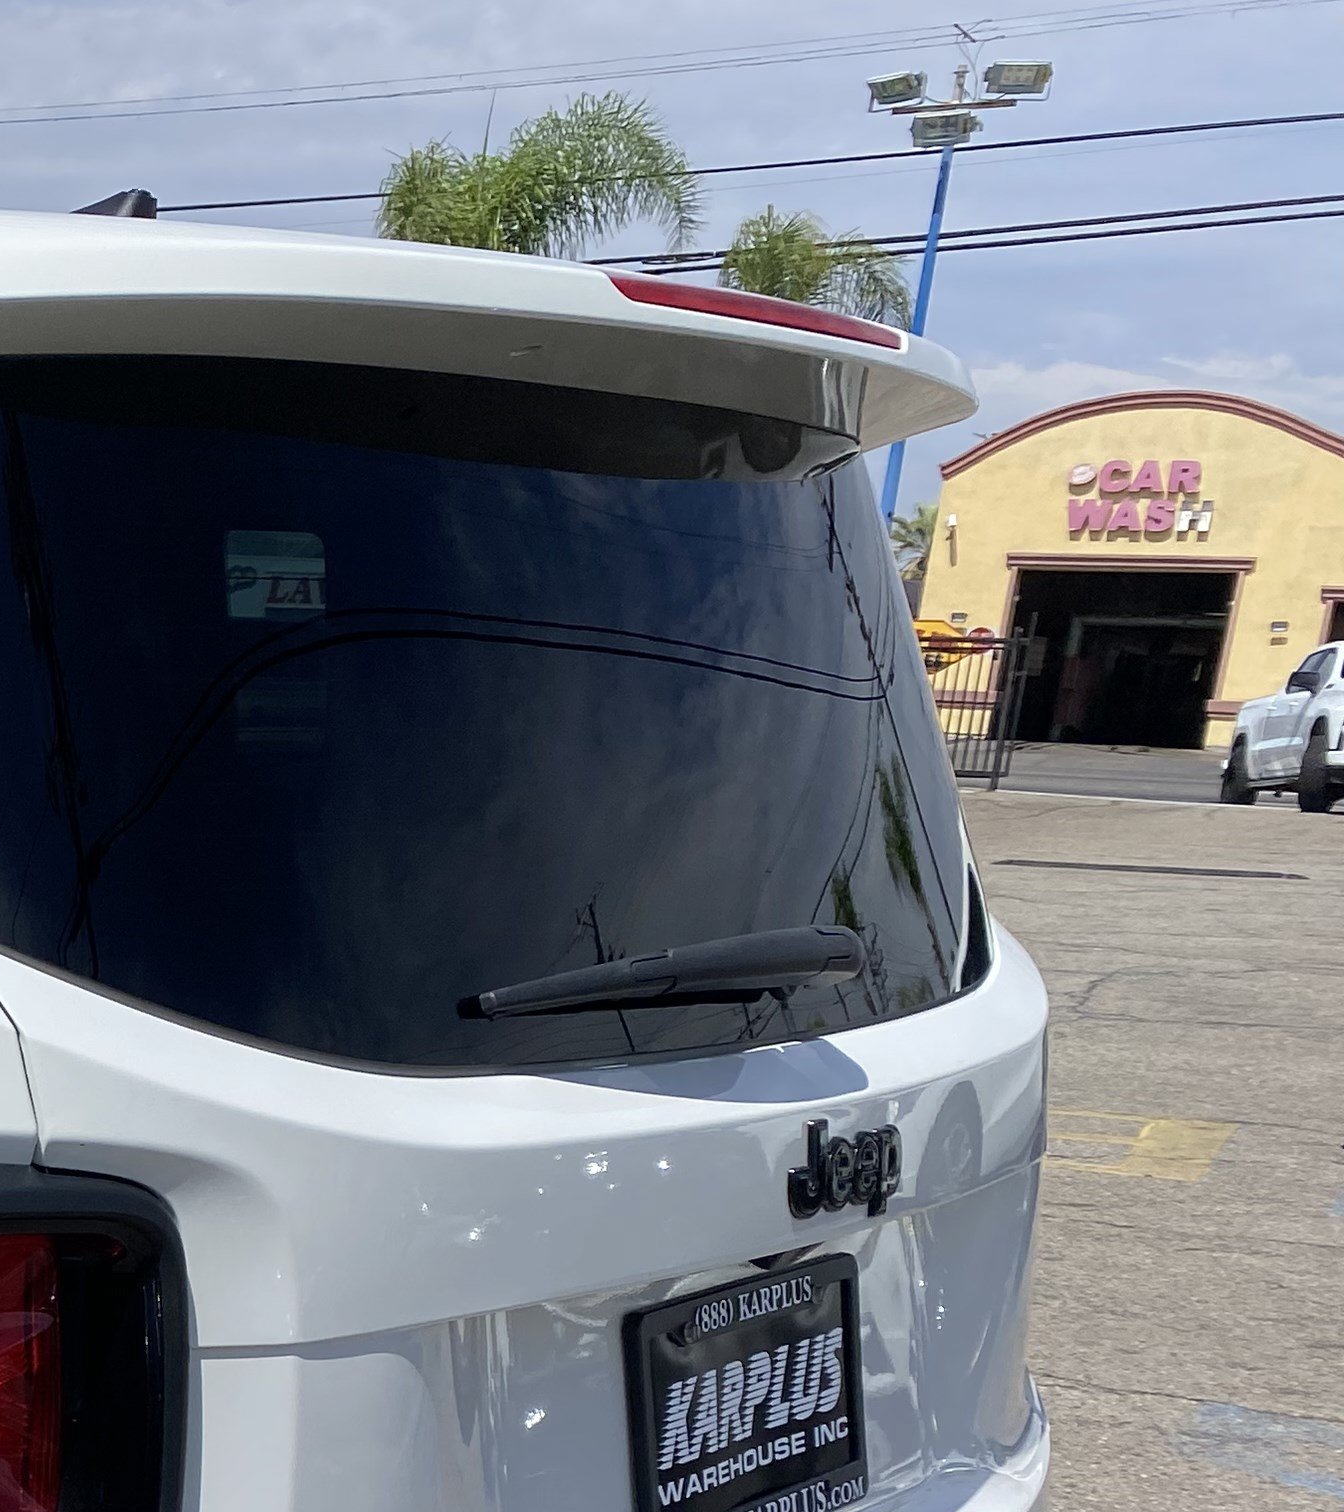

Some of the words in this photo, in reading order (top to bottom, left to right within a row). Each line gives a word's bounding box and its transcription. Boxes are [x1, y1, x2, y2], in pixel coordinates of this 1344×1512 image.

[1099, 459, 1202, 493] CAR
[1068, 498, 1215, 533] WASH
[787, 1118, 902, 1220] Jeep
[695, 1298, 734, 1333] (888)
[738, 1275, 812, 1322] KARPLUS
[656, 1326, 844, 1471] KARPLUS
[658, 1431, 807, 1507] WAREHOUSE
[814, 1415, 849, 1448] INC
